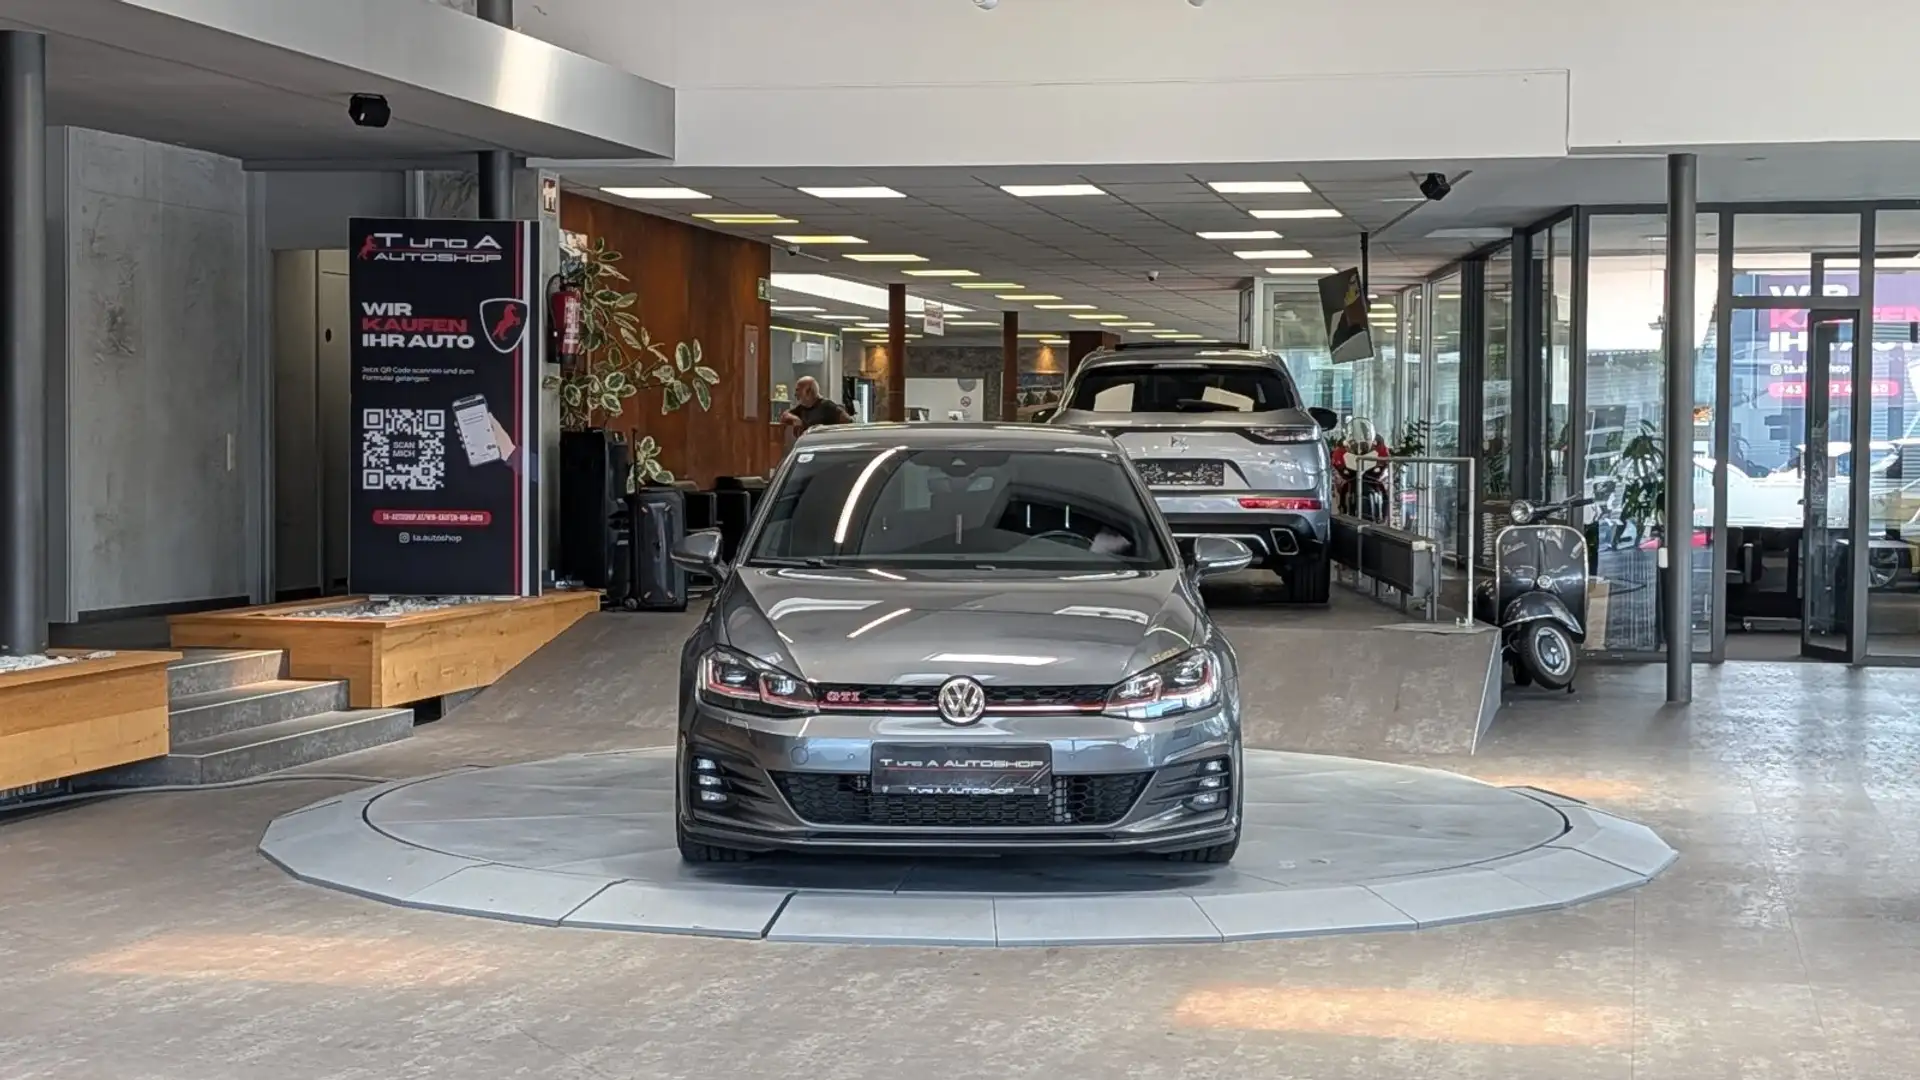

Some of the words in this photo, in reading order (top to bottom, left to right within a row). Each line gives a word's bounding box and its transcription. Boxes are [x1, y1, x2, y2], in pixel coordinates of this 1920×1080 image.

[373, 233, 403, 248] T
[473, 235, 502, 249] A
[373, 252, 502, 263] AUTOSHOP
[361, 302, 413, 316] WIR
[361, 318, 468, 333] KAUFEN
[361, 334, 405, 348] IHR
[407, 335, 475, 349] AUTO
[392, 441, 416, 449] SCAN
[392, 449, 416, 457] MICH
[412, 534, 462, 543] ta.autoshop
[826, 691, 861, 702] GTI
[880, 758, 893, 766] T
[927, 759, 939, 767] A
[943, 759, 1044, 768] AUTOSHOP
[947, 787, 1014, 795] AUTOSHOP
